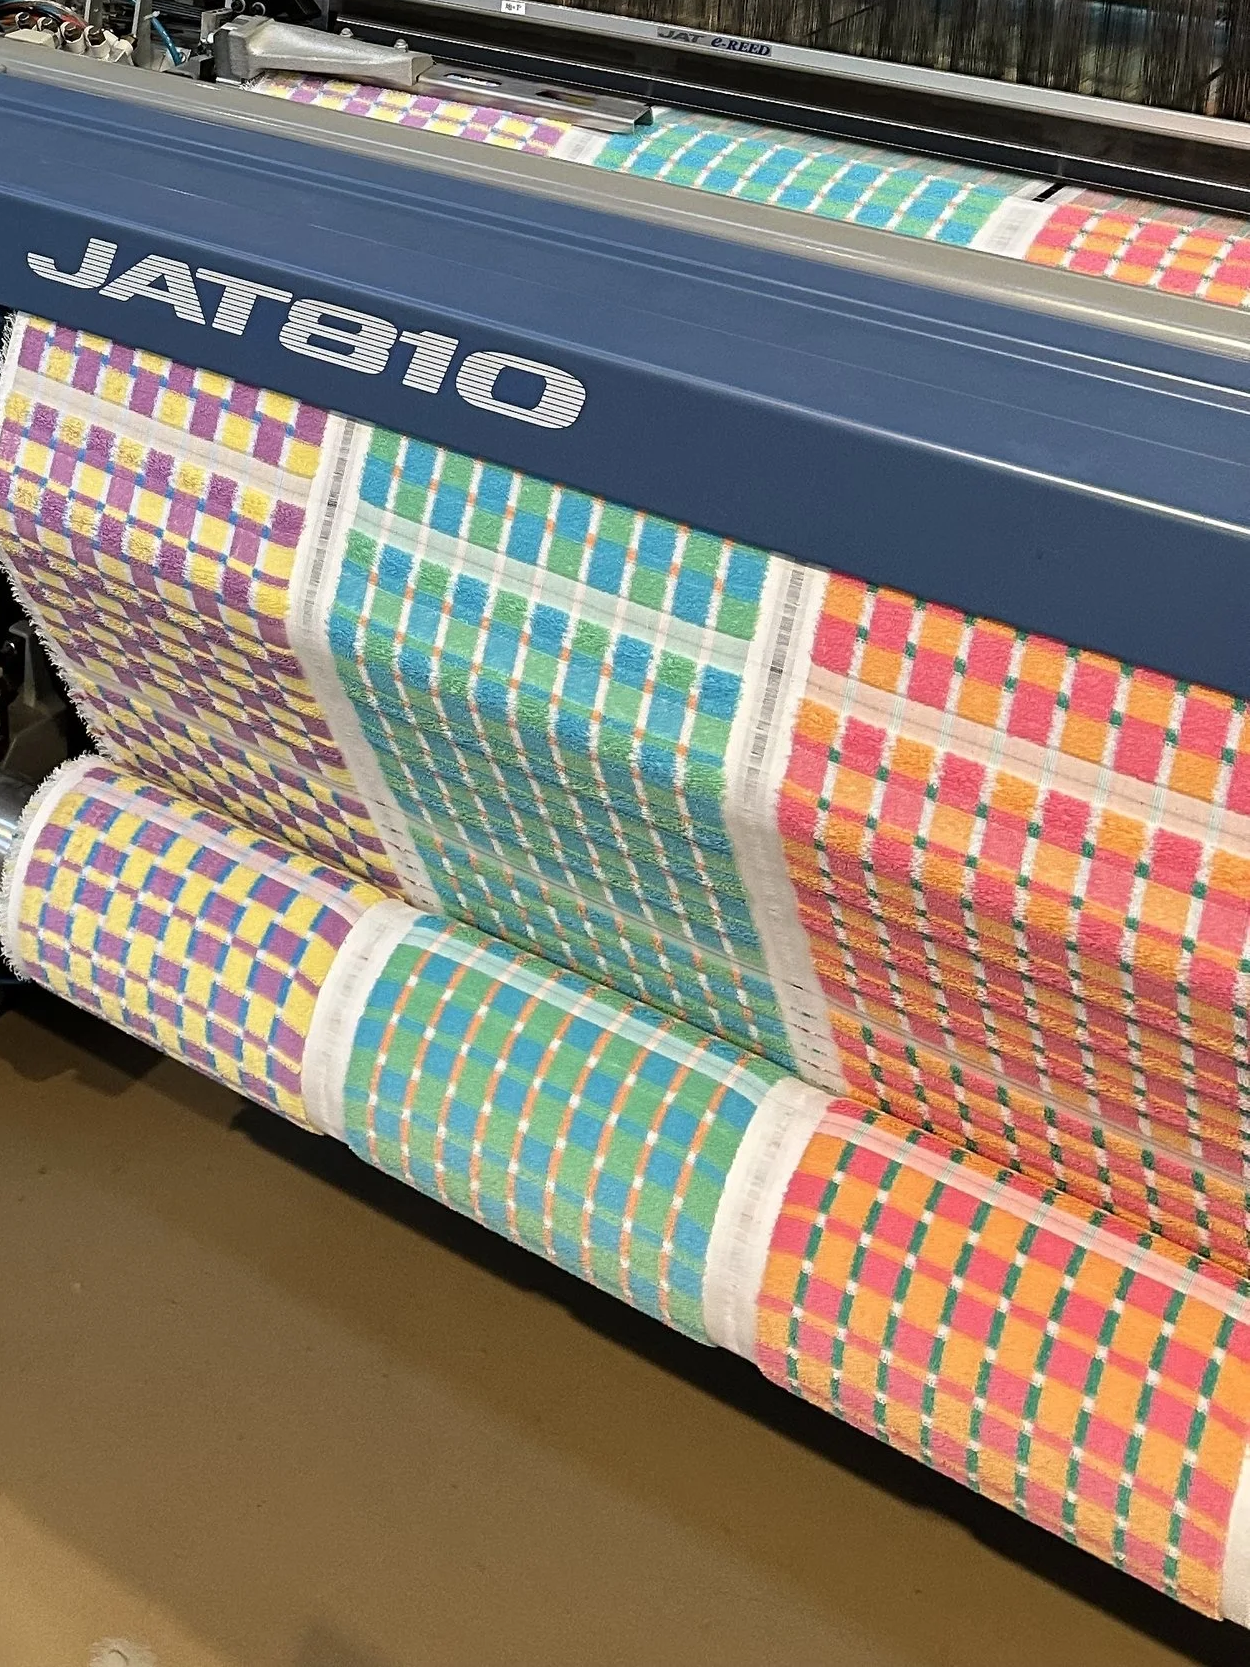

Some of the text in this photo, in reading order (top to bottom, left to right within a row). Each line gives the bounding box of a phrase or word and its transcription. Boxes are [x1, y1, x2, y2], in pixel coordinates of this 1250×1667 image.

[657, 30, 771, 56] JAT e-REED
[26, 237, 587, 430] JAT810
